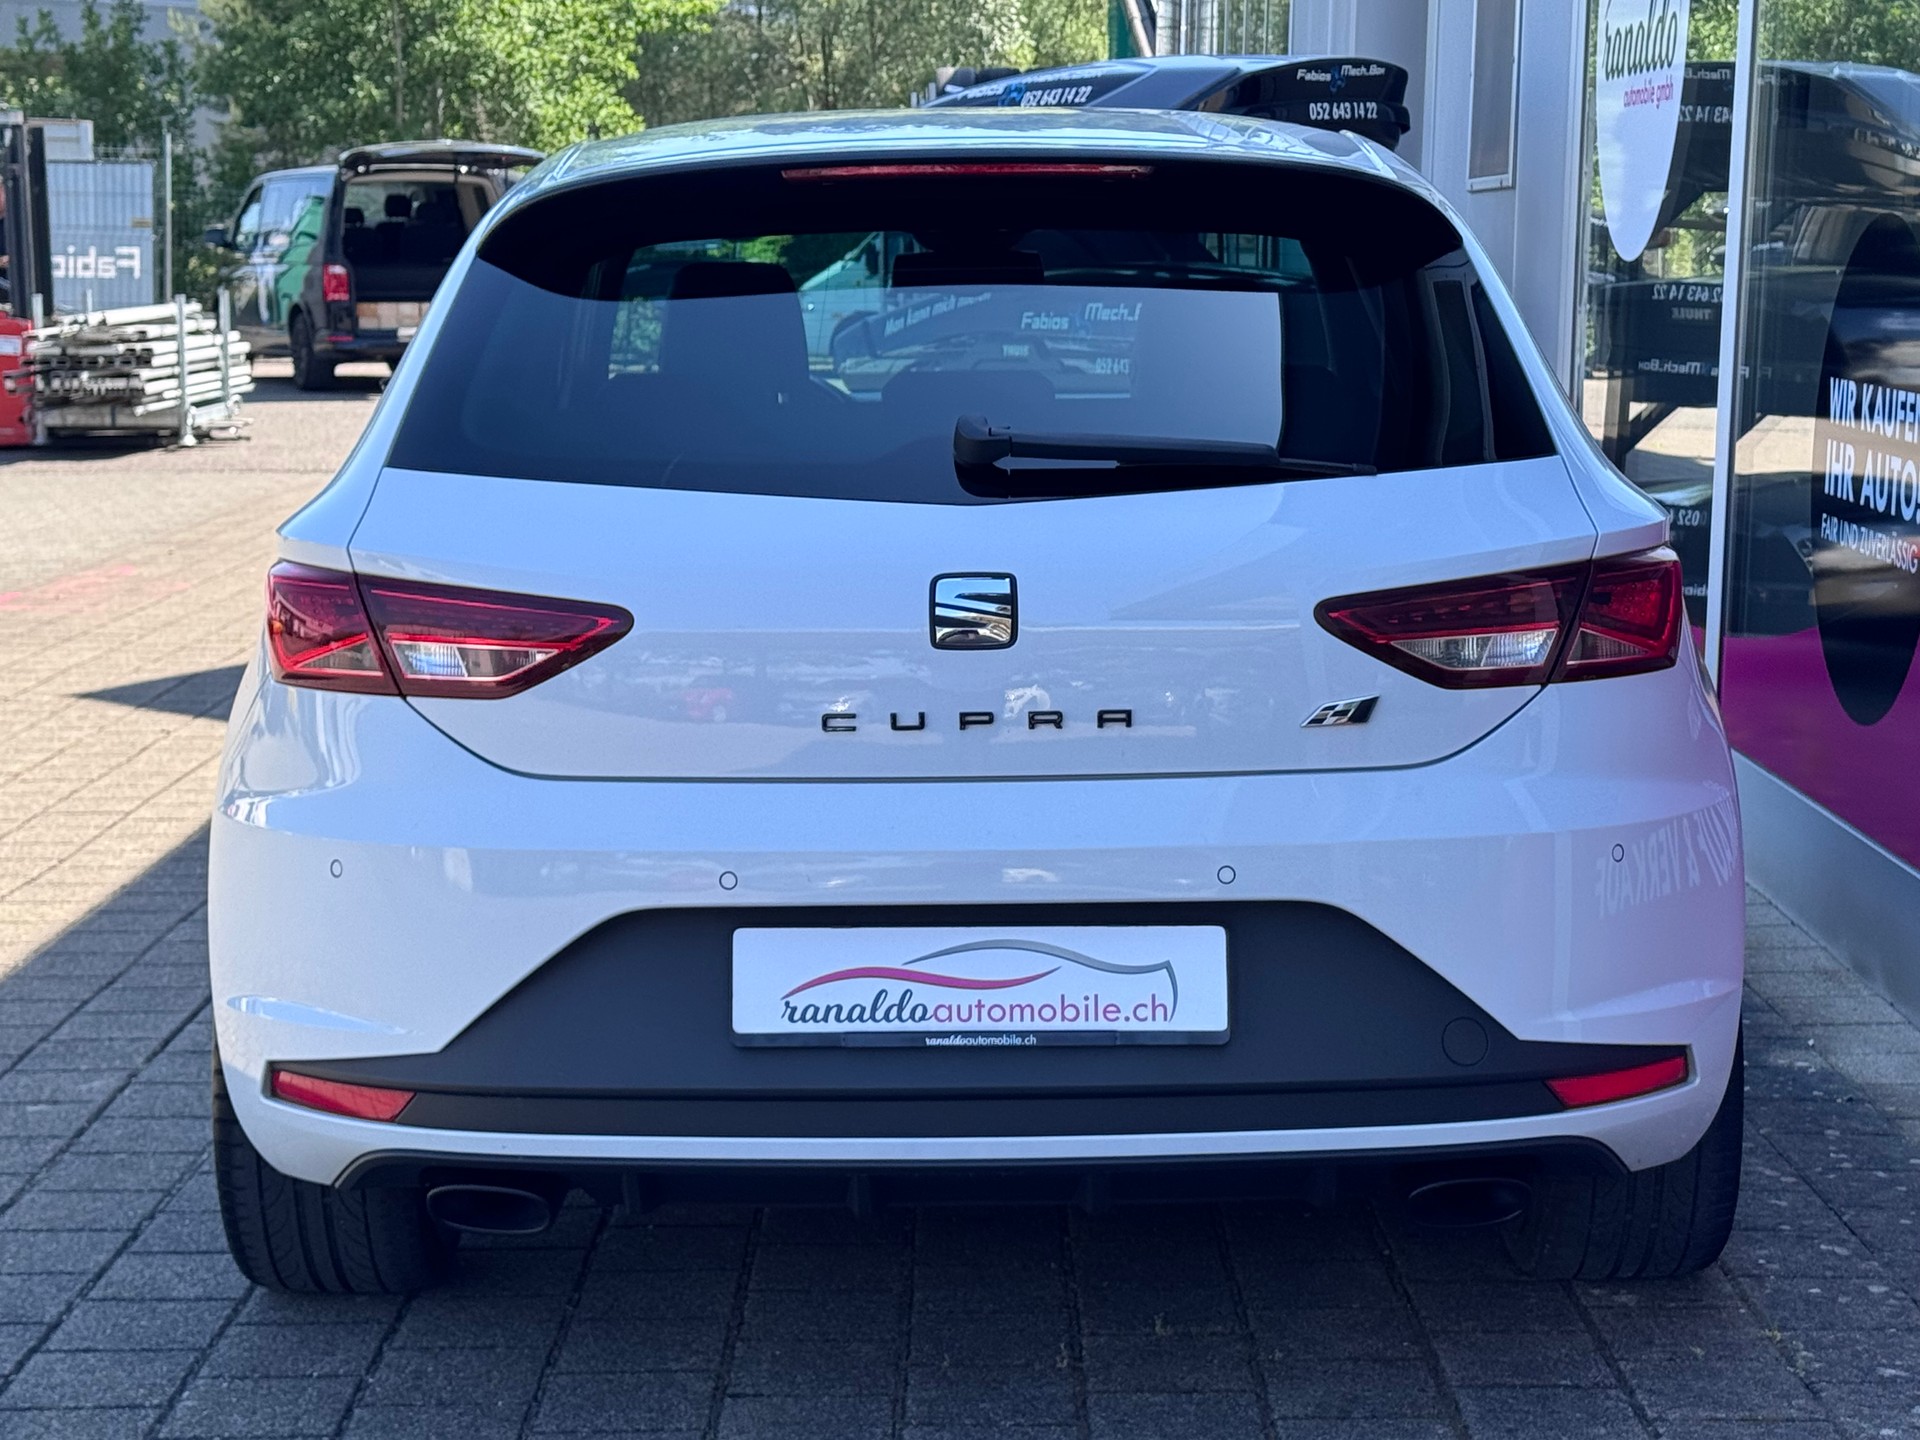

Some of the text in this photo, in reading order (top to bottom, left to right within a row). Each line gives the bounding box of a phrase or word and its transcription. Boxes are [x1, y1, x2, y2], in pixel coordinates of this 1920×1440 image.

[1602, 0, 1677, 81] ranaldo
[1296, 69, 1332, 82] Fabios
[1073, 85, 1094, 103] 22
[1624, 74, 1673, 109] automobile gmbh
[1309, 101, 1379, 120] 052 643 14 22
[1021, 312, 1069, 330] Fabios
[1829, 376, 1857, 429] WIR
[1824, 439, 1855, 503] IHR
[1820, 512, 1919, 574] FAIR UND ZUVERLÄSSIG
[821, 708, 1133, 733] CUPRA
[781, 988, 1169, 1024] ranaldoautomobile.ch
[925, 1033, 1037, 1047] ranaldoautomobile.ch
